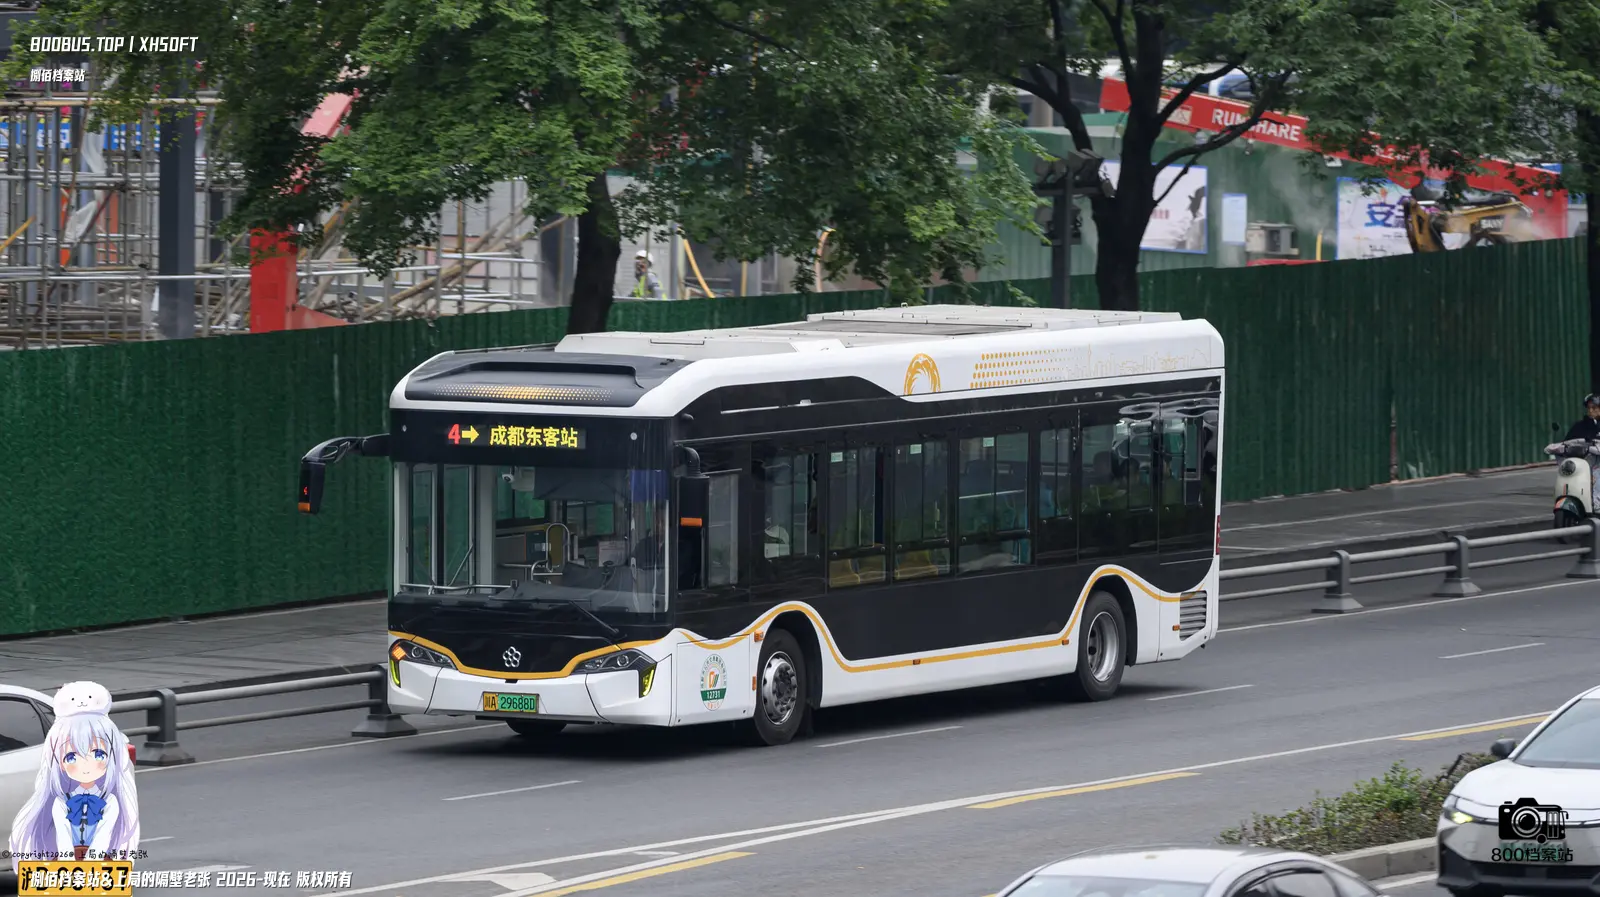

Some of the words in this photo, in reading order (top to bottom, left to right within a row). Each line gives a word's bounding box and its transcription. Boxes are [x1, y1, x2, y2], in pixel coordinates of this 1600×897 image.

[447, 423, 461, 445] 4
[489, 424, 579, 448] 成都东客站
